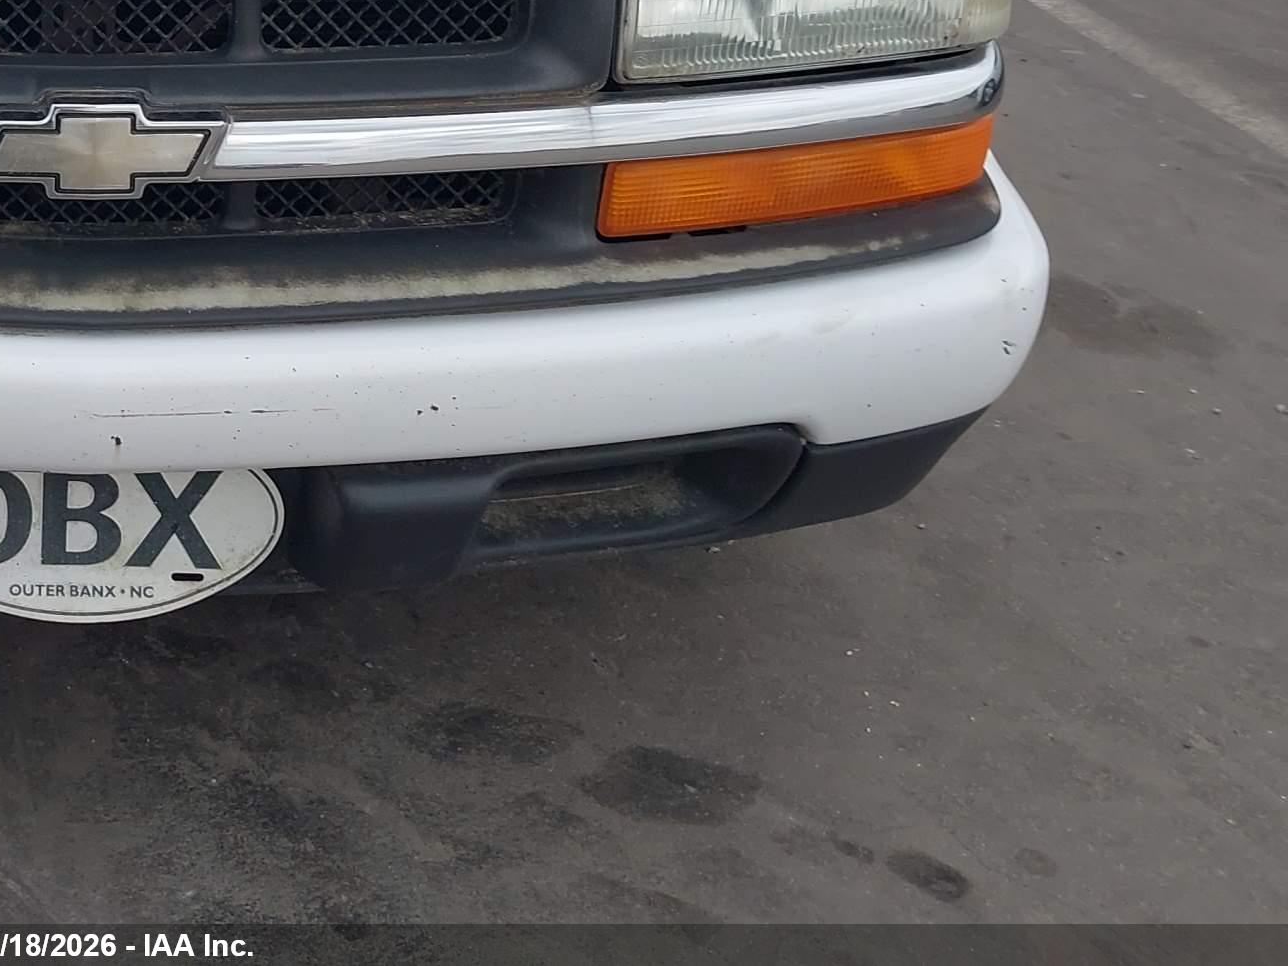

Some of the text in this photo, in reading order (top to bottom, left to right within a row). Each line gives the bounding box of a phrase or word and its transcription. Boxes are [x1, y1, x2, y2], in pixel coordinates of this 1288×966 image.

[9, 584, 65, 598] OUTER
[70, 584, 116, 598] BANX
[130, 585, 154, 599] NC
